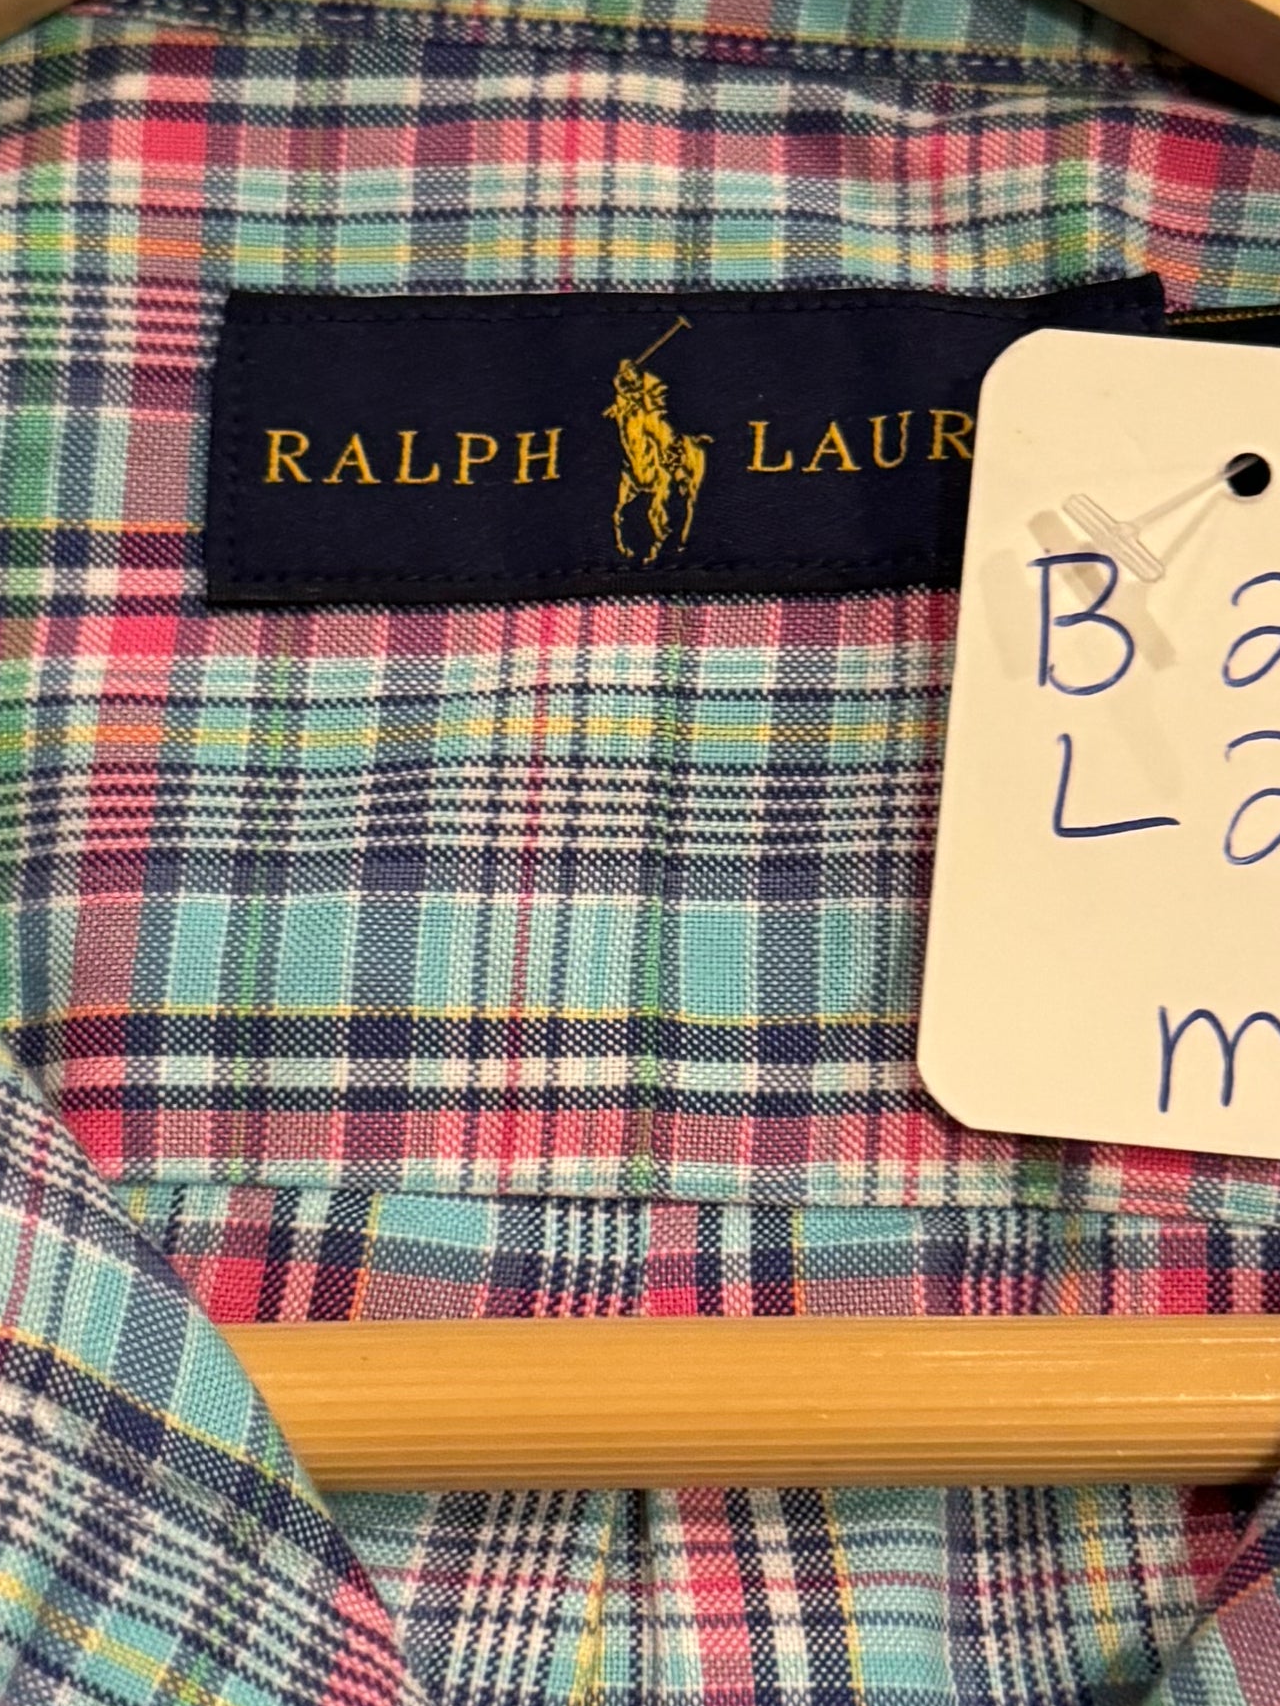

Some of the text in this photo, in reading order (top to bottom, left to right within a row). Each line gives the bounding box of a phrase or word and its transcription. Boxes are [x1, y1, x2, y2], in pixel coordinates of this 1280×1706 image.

[263, 407, 976, 486] RALPH LAUR
[1026, 550, 1136, 696] B
[1052, 733, 1180, 841] L
